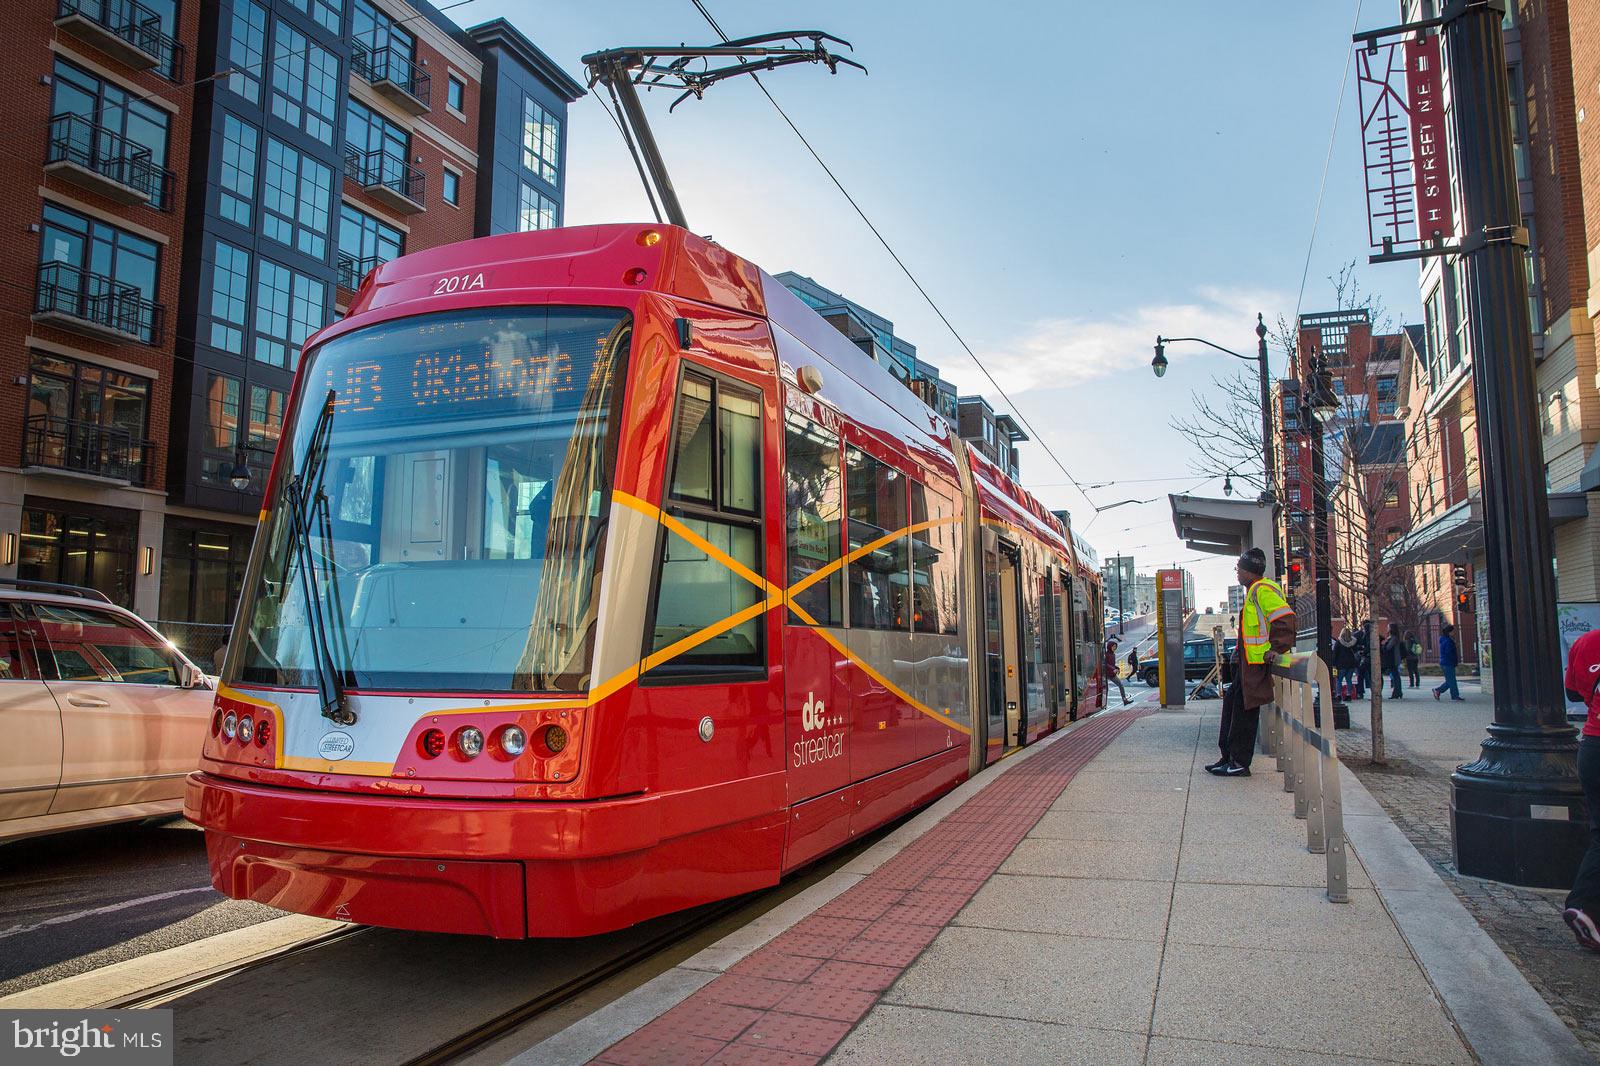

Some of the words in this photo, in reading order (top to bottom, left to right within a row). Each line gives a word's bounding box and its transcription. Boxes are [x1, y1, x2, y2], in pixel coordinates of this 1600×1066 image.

[1420, 123, 1440, 197] STREET
[1427, 208, 1441, 221] H
[433, 272, 485, 295] 201A
[411, 345, 577, 406] Oklahoma
[802, 691, 825, 732] dc
[323, 744, 352, 752] STREETCAR
[793, 730, 845, 768] streetcar
